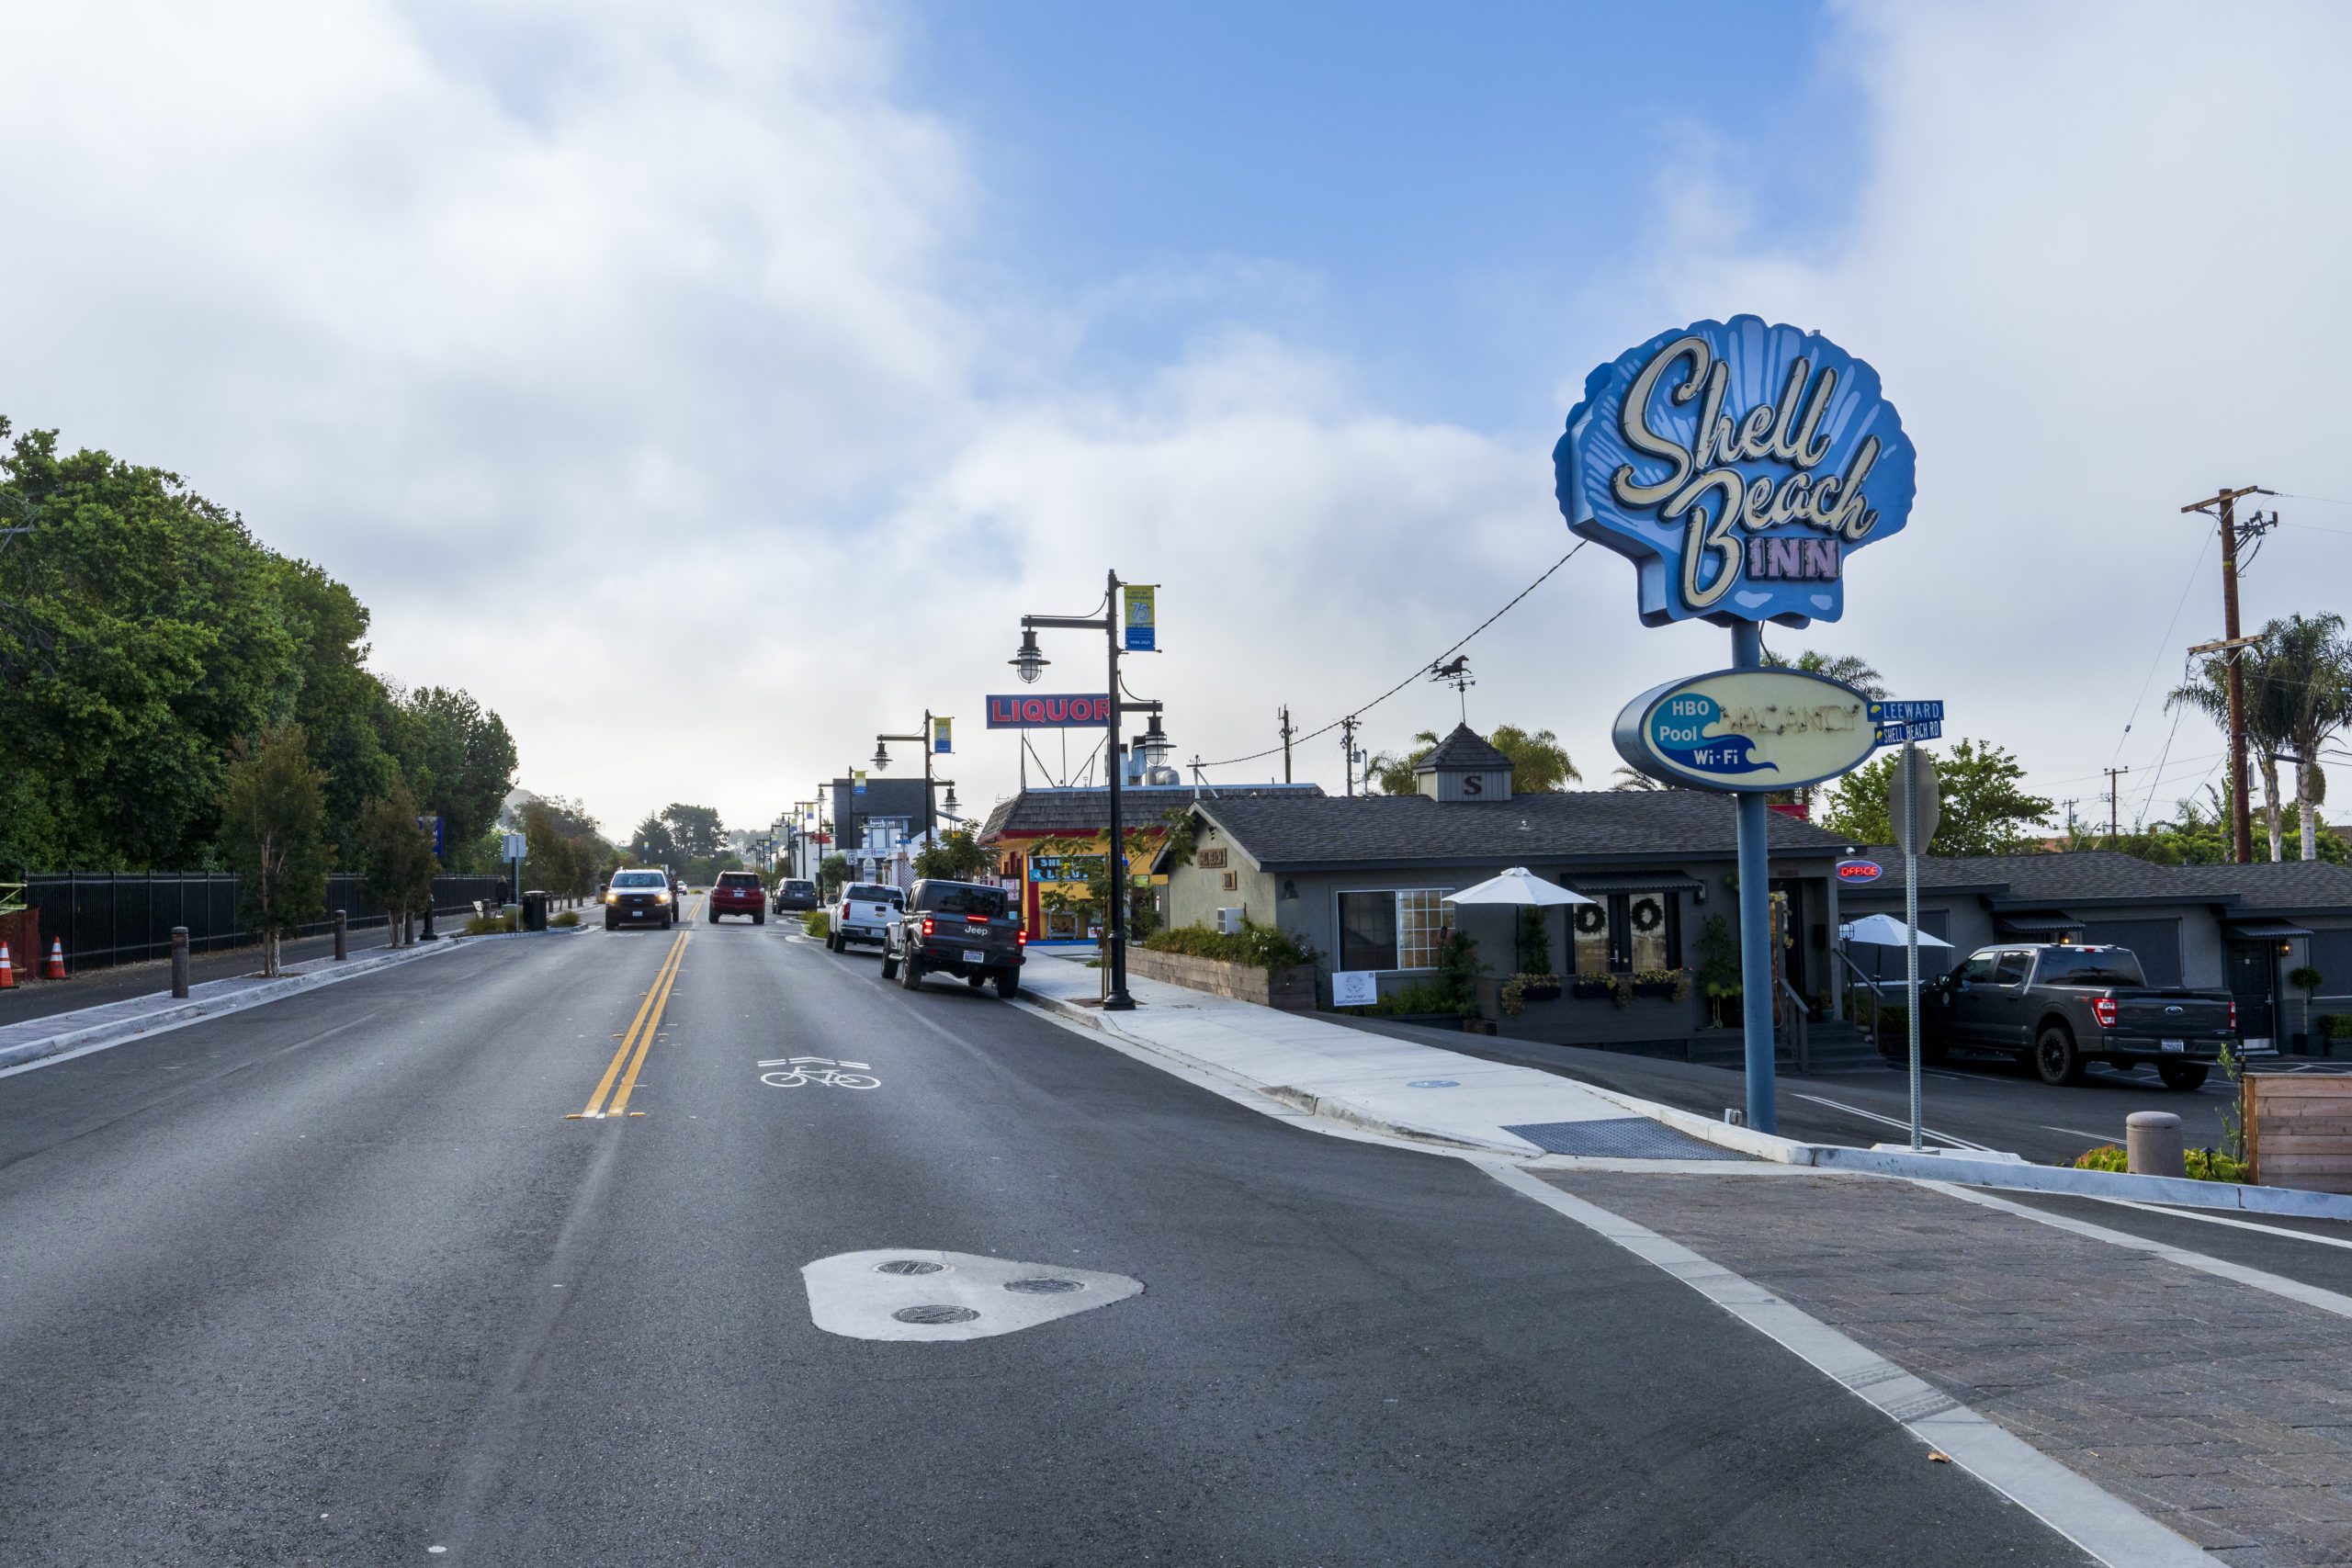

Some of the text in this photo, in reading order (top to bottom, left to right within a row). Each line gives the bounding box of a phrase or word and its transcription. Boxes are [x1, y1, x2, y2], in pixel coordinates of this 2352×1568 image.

[1611, 335, 1832, 509] Shell
[1659, 434, 1883, 610] Beach
[1746, 536, 1840, 581] INN
[992, 698, 1110, 723] LIQUOR
[1672, 701, 1709, 716] HBO
[1883, 703, 1939, 718] LEEWARD
[1659, 726, 1697, 741] Pool
[1883, 720, 1939, 743] SHELL BEACH RD
[1693, 750, 1738, 765] Wi-Fi
[1464, 775, 1482, 795] S
[1841, 866, 1877, 876] OFFICE
[965, 925, 989, 937] Jeep
